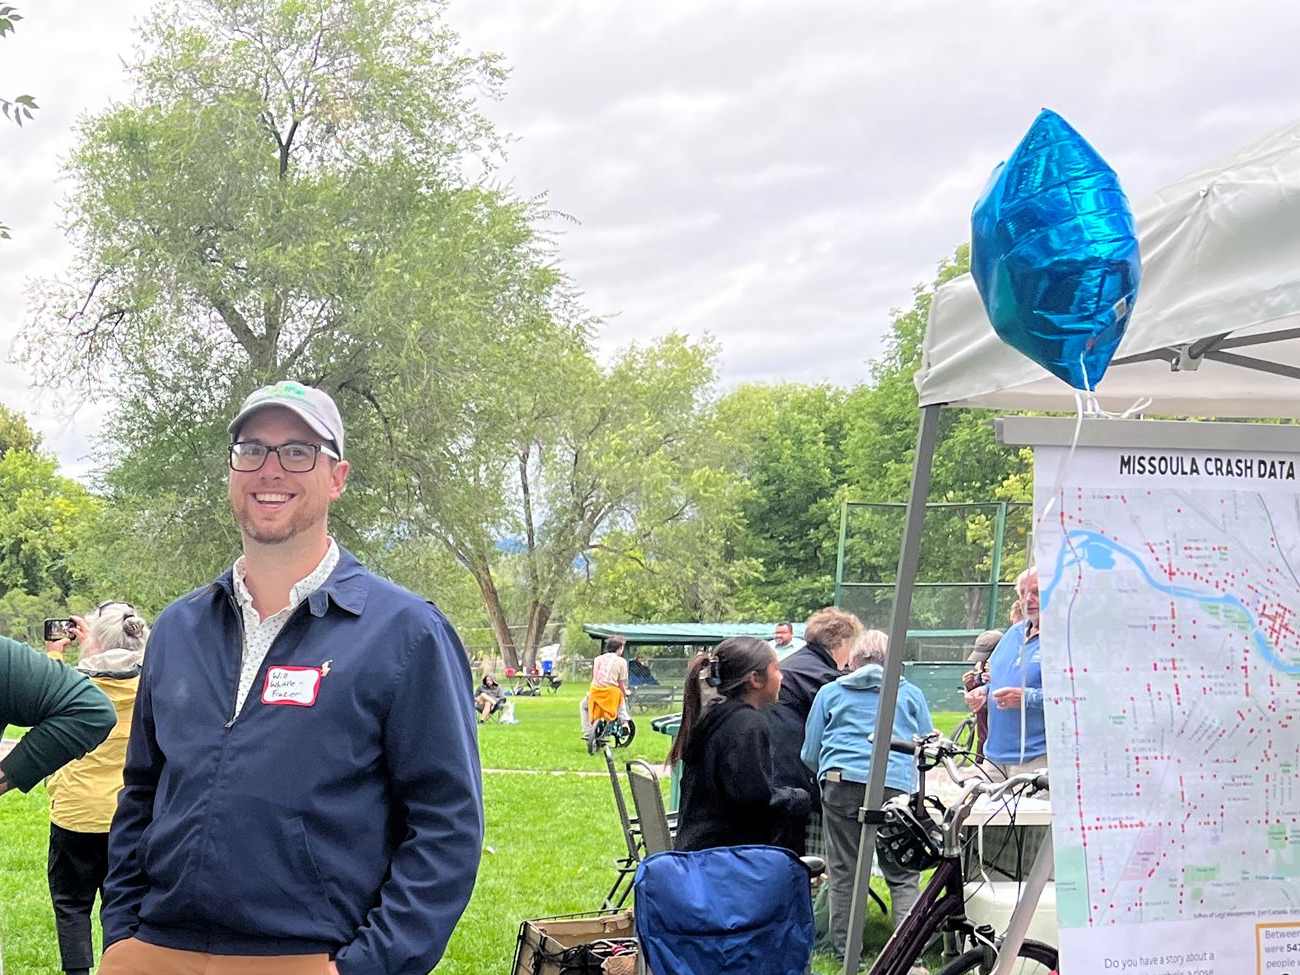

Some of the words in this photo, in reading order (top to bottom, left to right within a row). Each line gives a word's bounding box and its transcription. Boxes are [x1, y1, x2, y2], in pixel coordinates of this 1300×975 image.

[1119, 455, 1200, 476] MISSOULA
[1204, 457, 1253, 478] CRASH
[1258, 459, 1295, 480] DATA
[1104, 958, 1120, 969] Do
[1121, 959, 1138, 970] you
[1140, 956, 1158, 966] have
[1165, 955, 1184, 966] story
[1186, 952, 1207, 962] about
[1266, 958, 1295, 969] people
